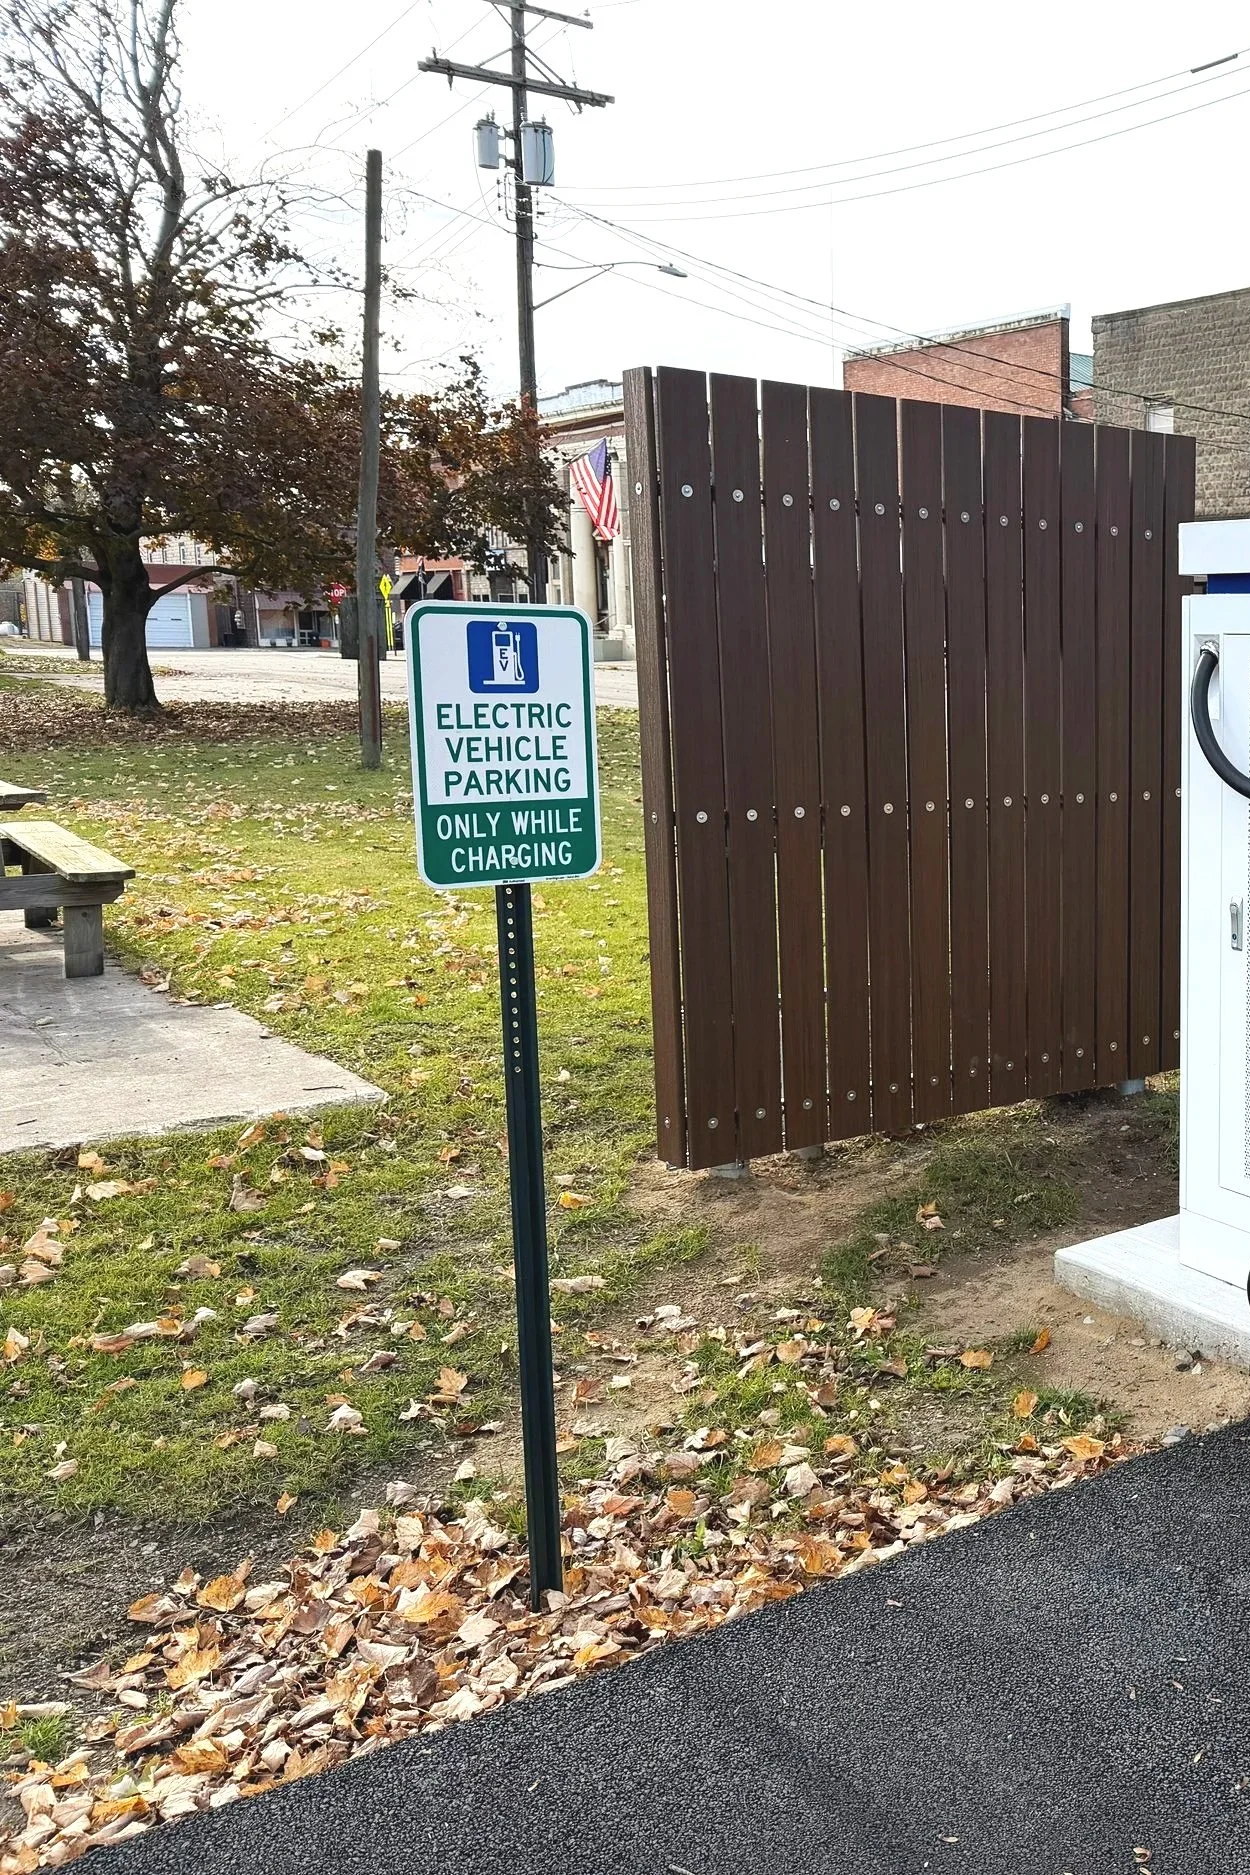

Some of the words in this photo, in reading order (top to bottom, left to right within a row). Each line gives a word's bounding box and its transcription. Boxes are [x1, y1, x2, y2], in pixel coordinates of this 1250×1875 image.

[499, 648, 509, 672] EV
[436, 702, 573, 730] ELECTRIC
[444, 735, 569, 763] VEHICLE
[444, 767, 572, 797] PARKING
[436, 812, 502, 841] ONLY
[511, 808, 583, 837] WHILE
[451, 840, 573, 874] CHARGING
